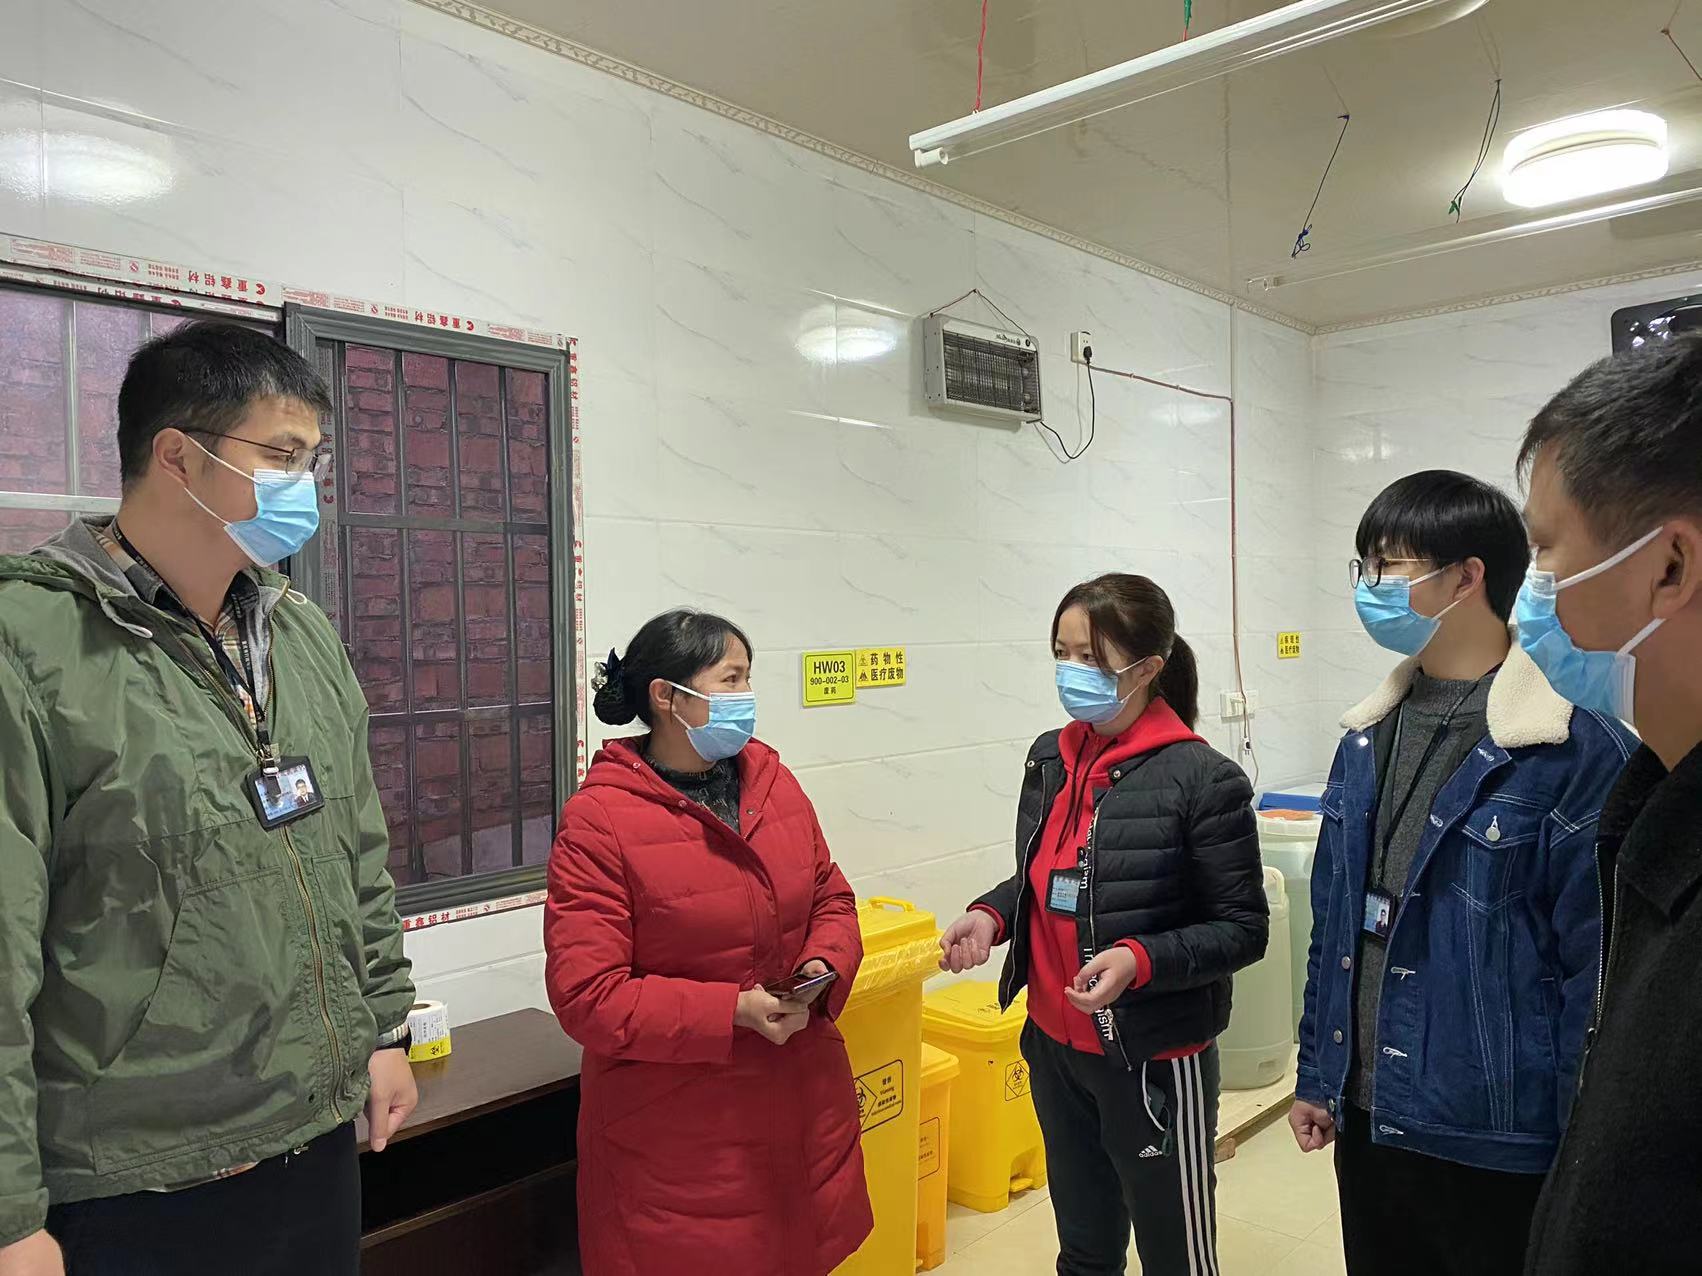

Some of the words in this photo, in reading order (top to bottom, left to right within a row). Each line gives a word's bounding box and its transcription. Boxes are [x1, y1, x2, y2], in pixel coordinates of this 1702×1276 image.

[188, 270, 248, 292] 重鑫铝材
[870, 651, 903, 666] 药物性
[813, 660, 846, 674] HW03
[870, 667, 904, 681] 医疗废物
[810, 675, 849, 685] 900-002-03
